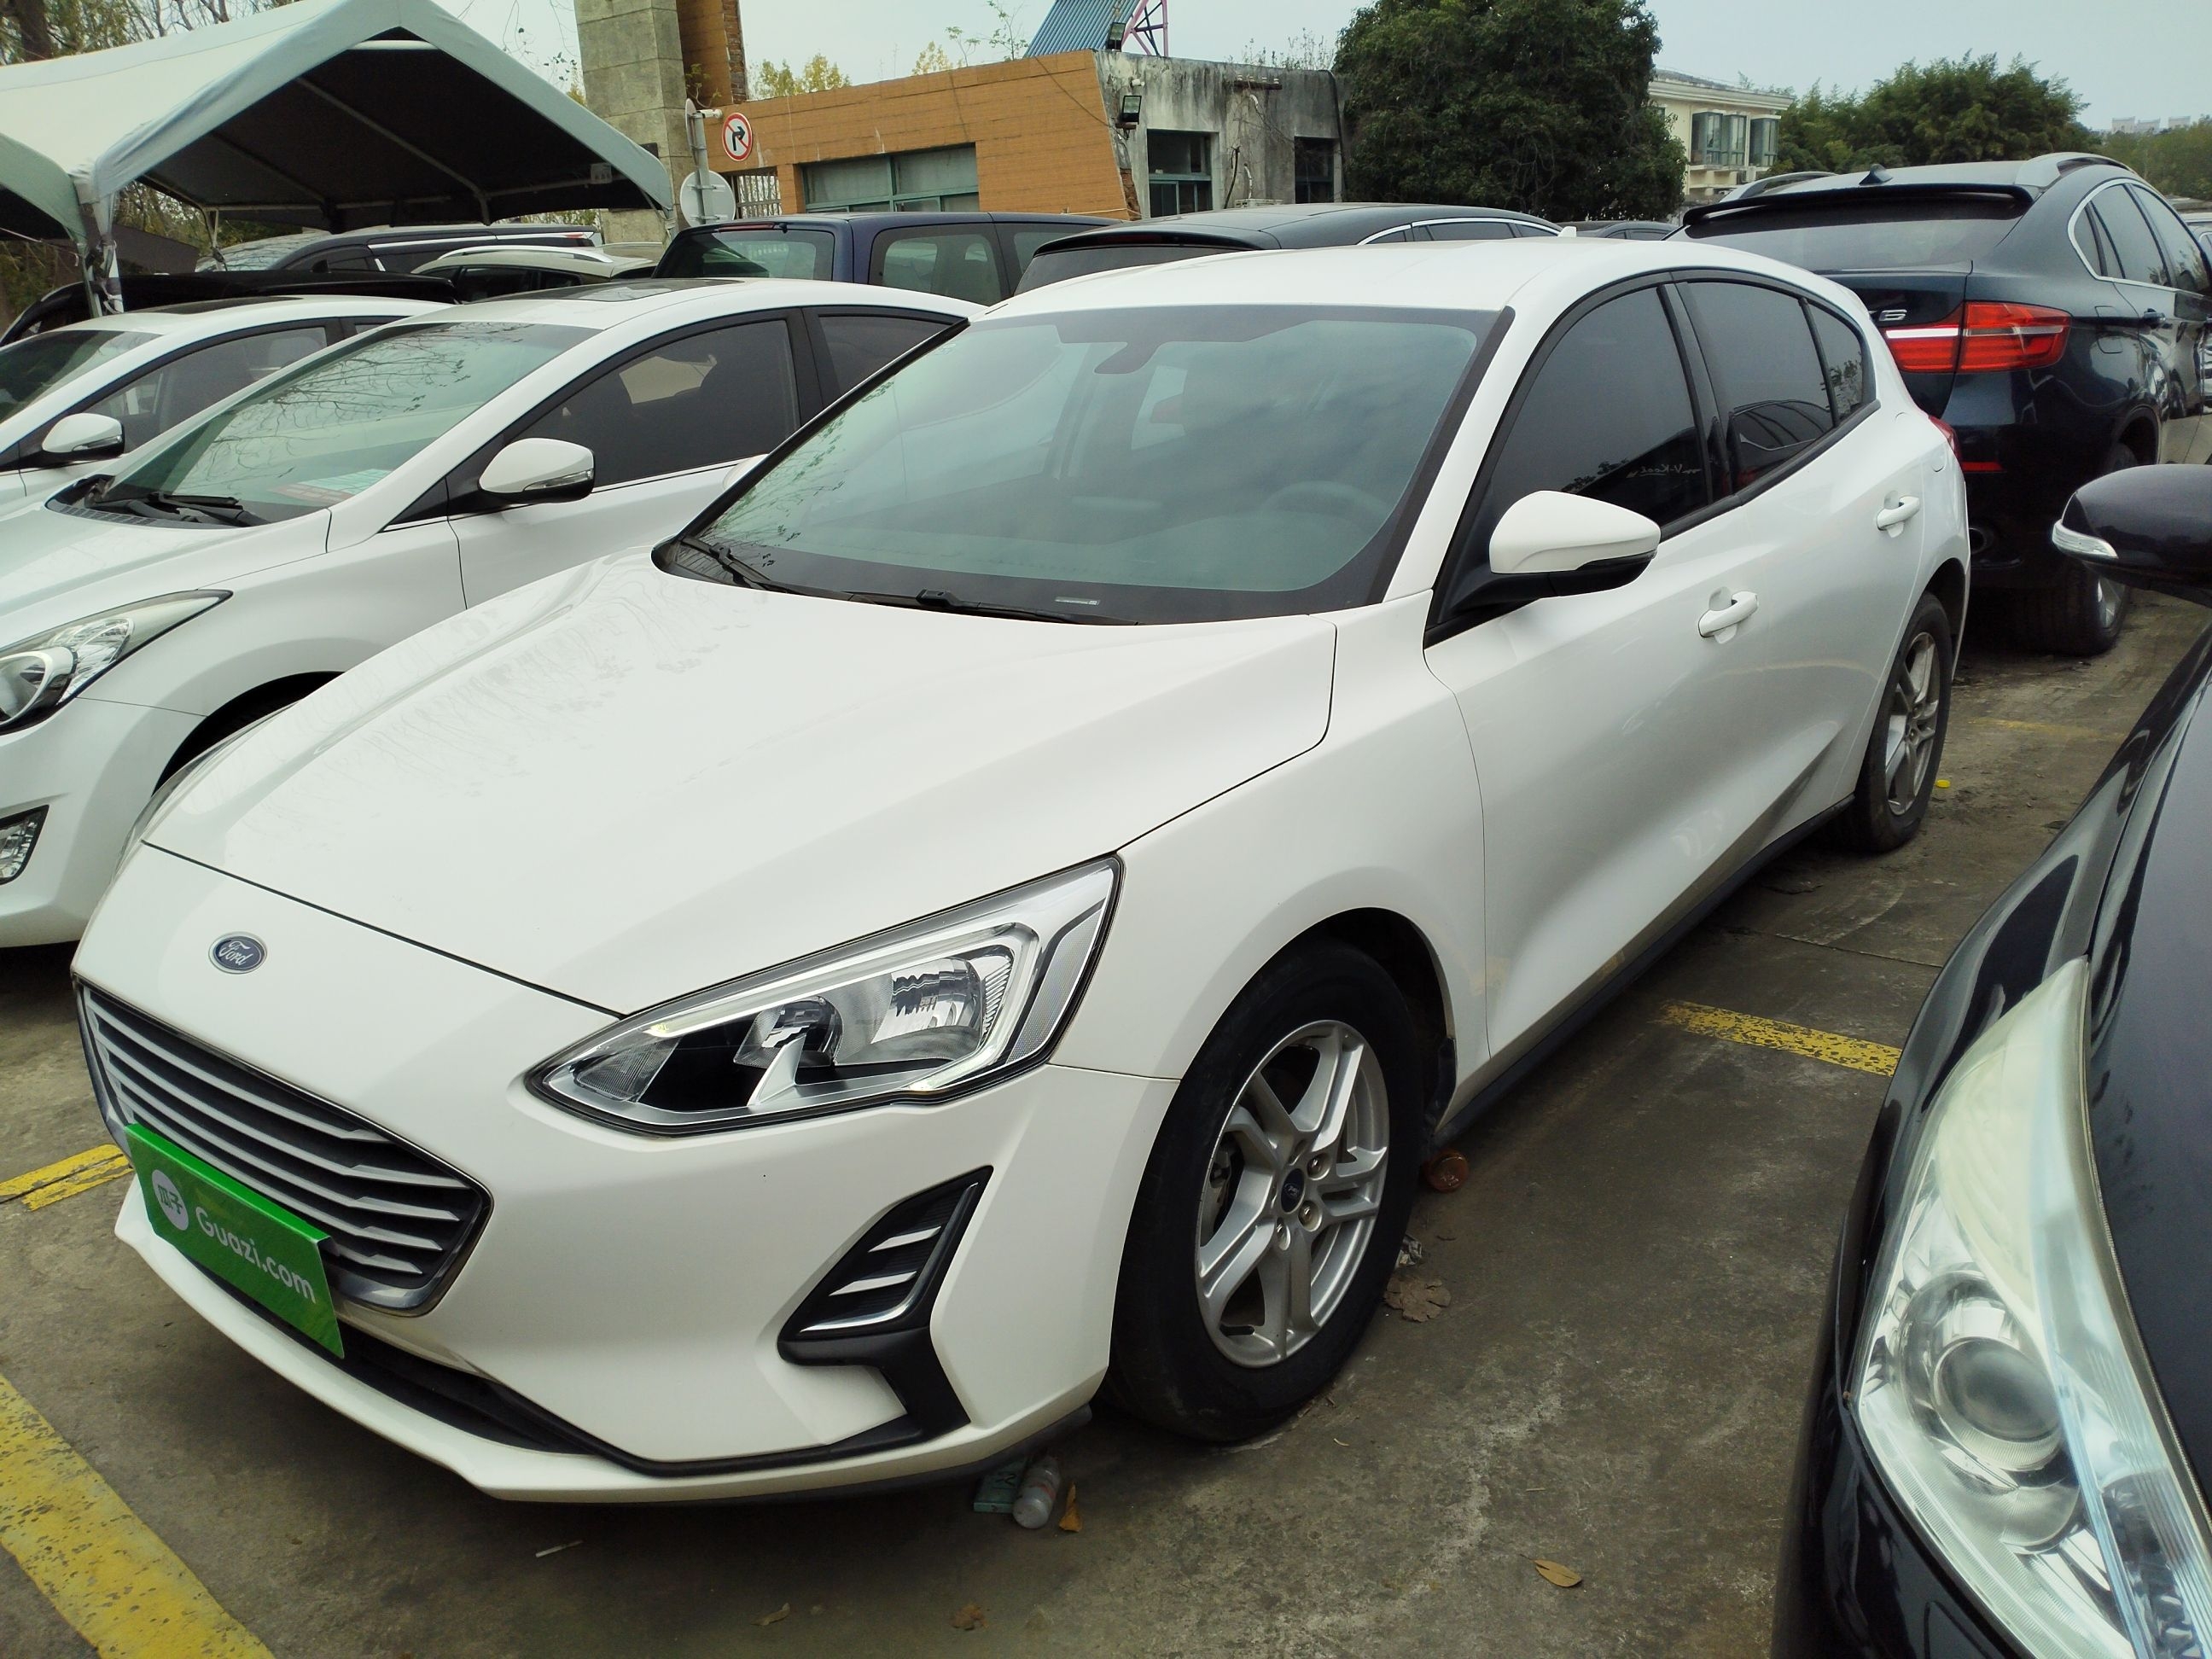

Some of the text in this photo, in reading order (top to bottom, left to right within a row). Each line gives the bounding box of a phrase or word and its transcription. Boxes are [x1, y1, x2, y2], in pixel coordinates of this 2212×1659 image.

[1868, 309, 1907, 322] 6
[218, 940, 253, 966] Ford
[195, 1207, 317, 1304] Guazi.com
